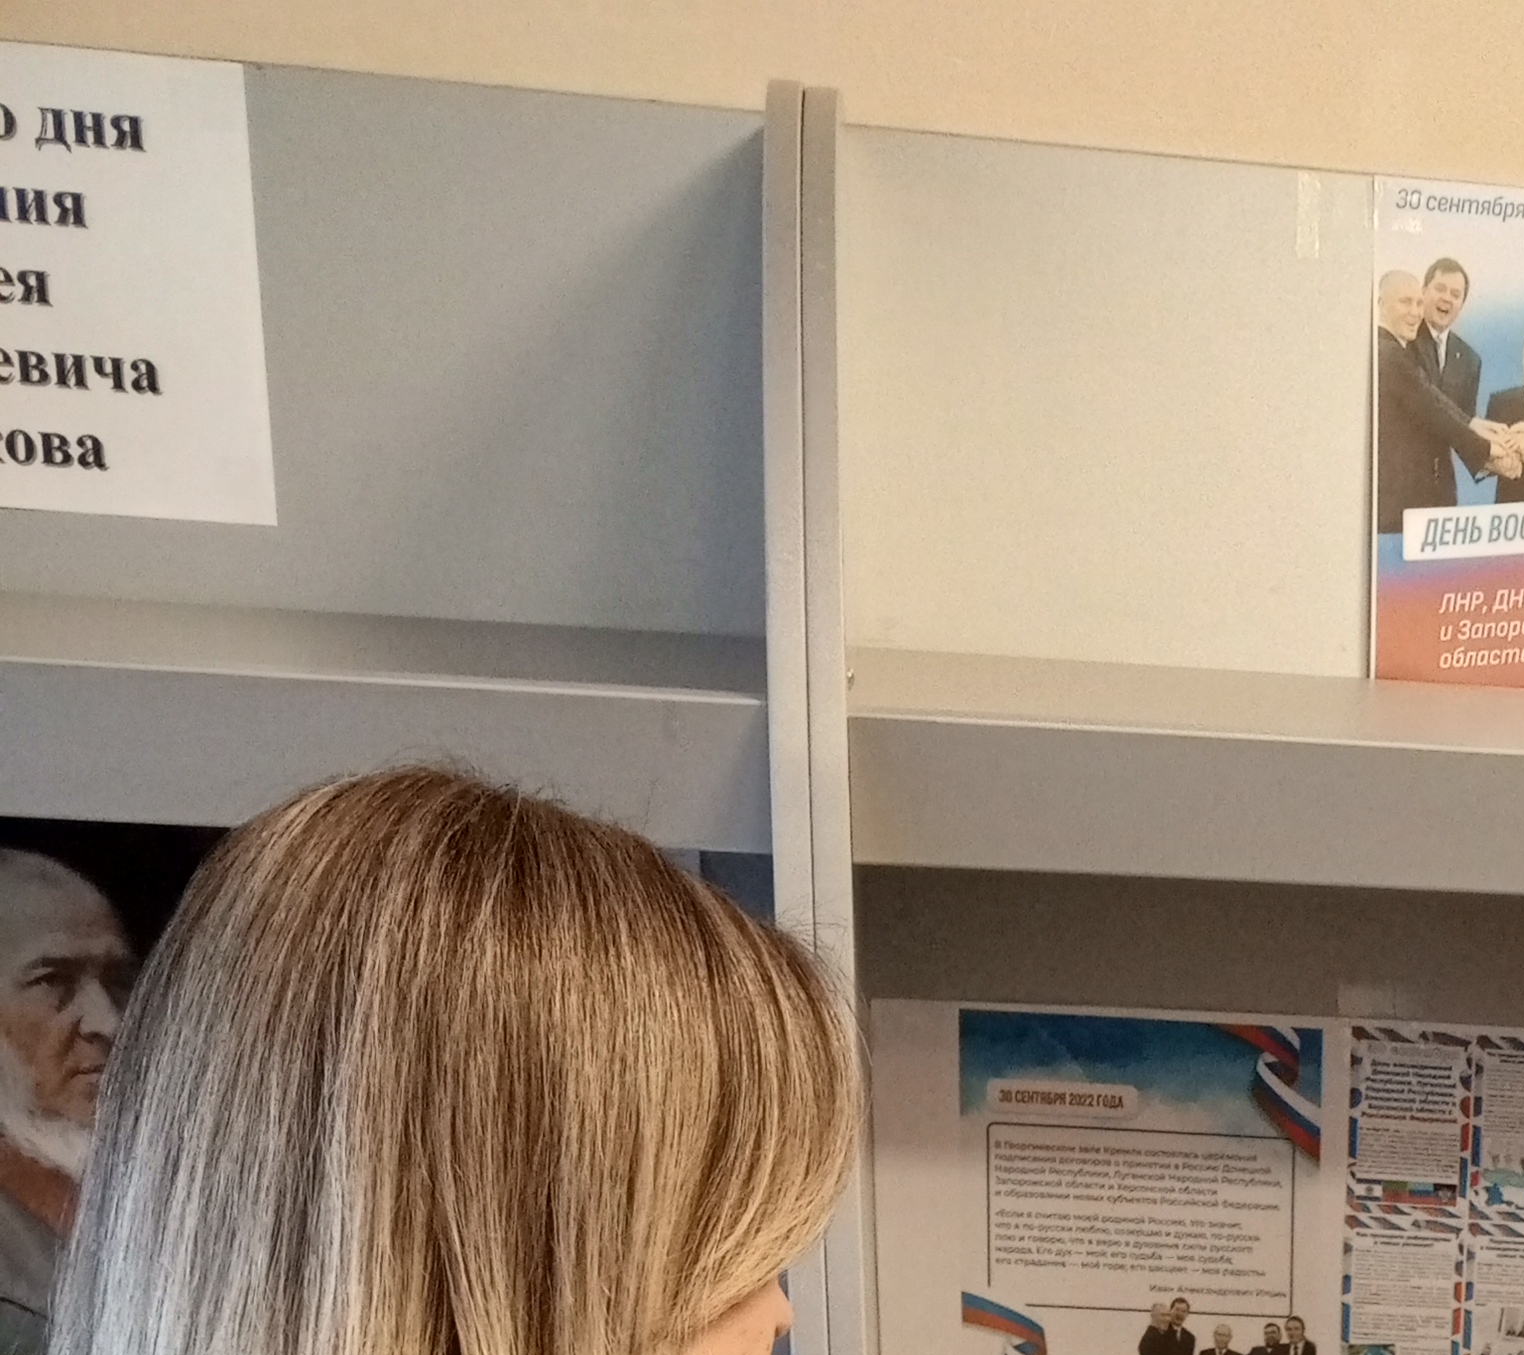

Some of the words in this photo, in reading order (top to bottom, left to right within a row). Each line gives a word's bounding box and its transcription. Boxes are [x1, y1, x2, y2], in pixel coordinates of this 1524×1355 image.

[36, 107, 147, 153] дня
[0, 184, 89, 229] ия
[1396, 188, 1422, 211] 30
[0, 426, 110, 472] ова
[1421, 509, 1482, 552] ДЕНЬ
[1439, 590, 1489, 616] ЛНР,
[1440, 624, 1453, 642] и
[1015, 1089, 1067, 1106] СЕНТЯБРЯ
[1068, 1092, 1094, 1107] 2022
[1096, 1093, 1125, 1109] ГОДА
